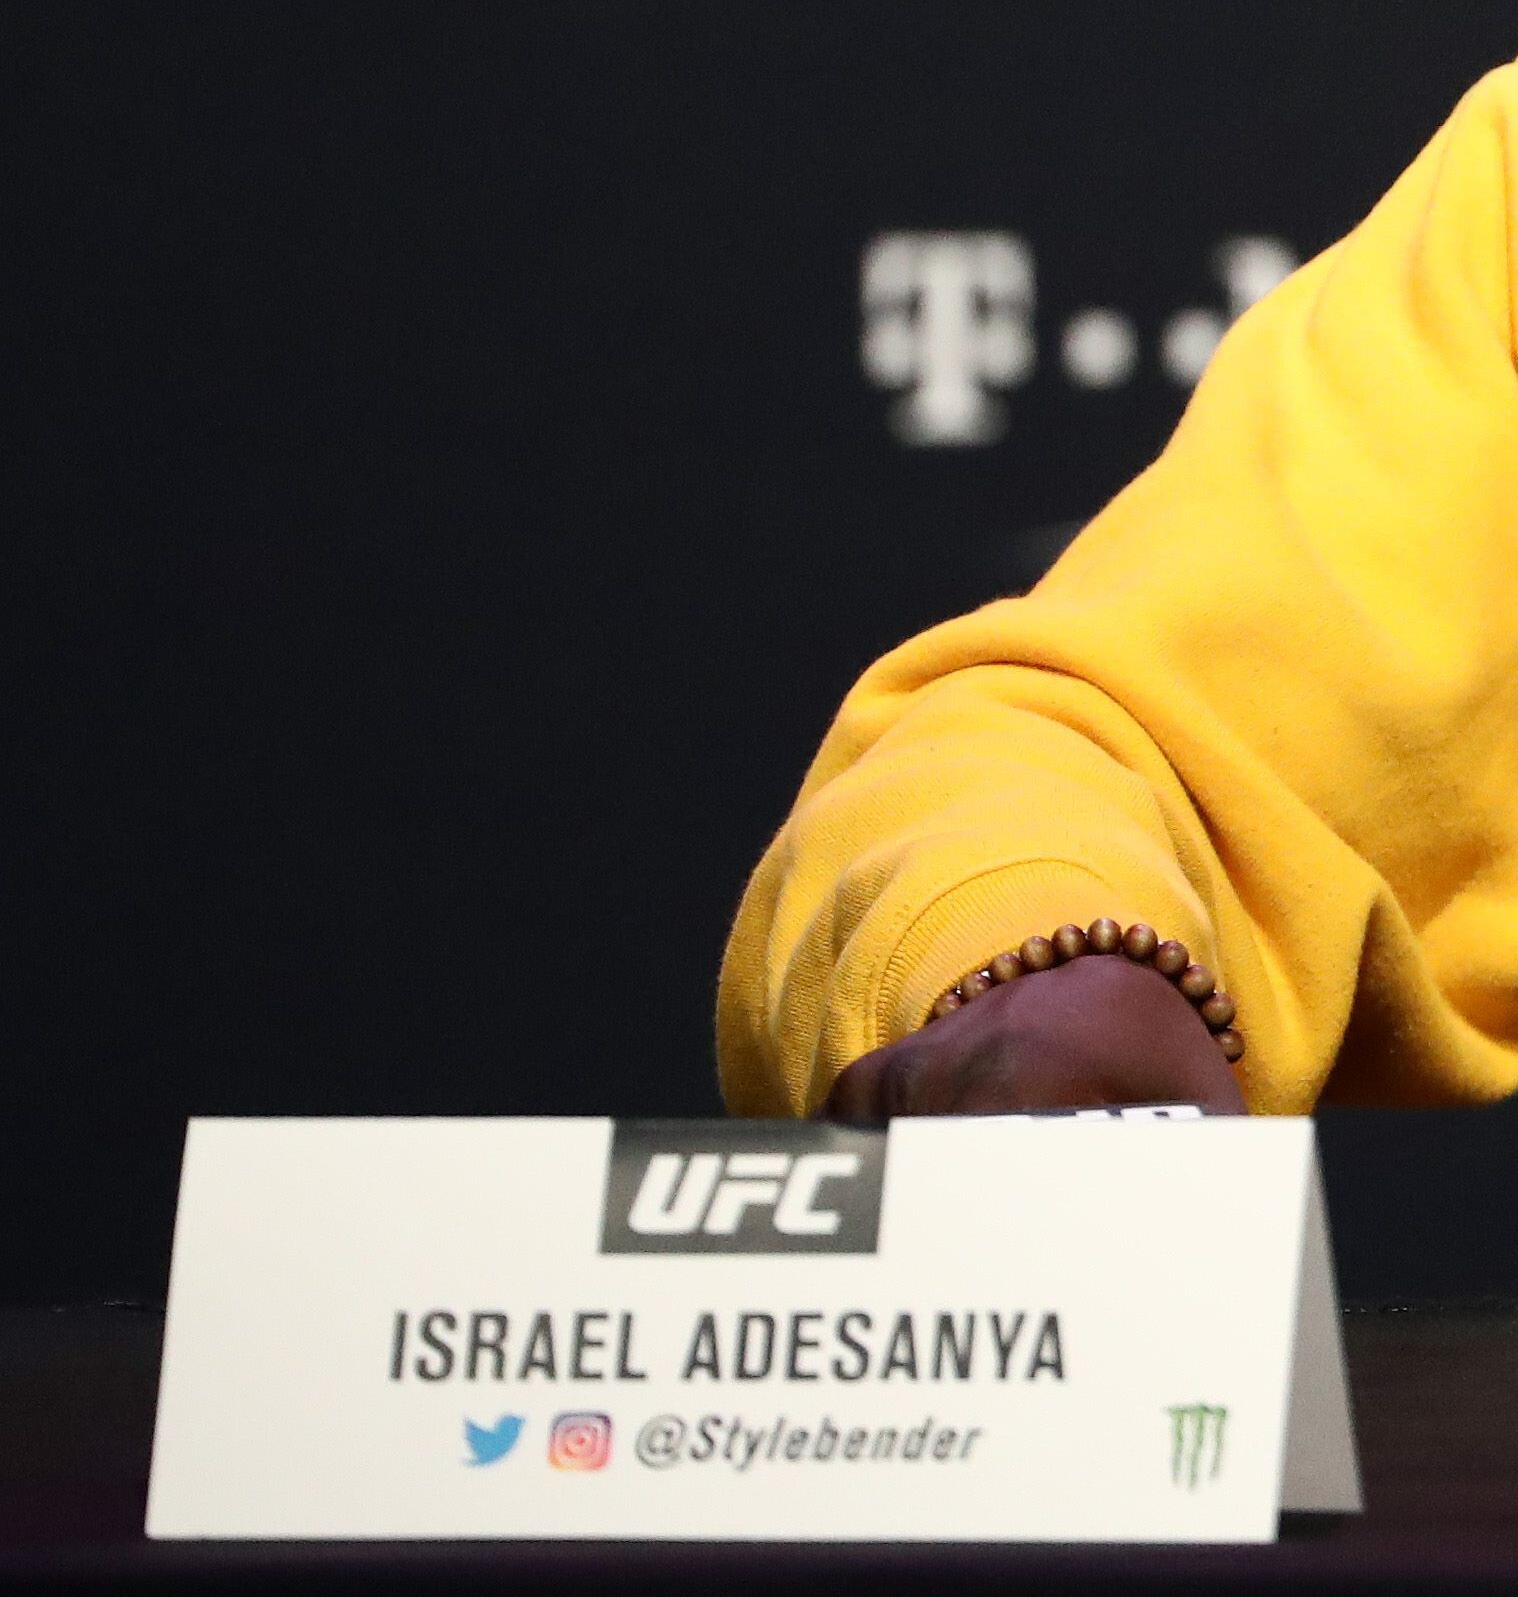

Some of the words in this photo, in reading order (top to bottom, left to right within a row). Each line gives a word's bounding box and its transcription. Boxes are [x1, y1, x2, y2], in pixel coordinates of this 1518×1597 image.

[627, 1152, 860, 1236] UFC
[389, 1309, 648, 1384] ISRAEL
[682, 1309, 1067, 1384] ADESANYA
[634, 1414, 983, 1471] @Stylebender
